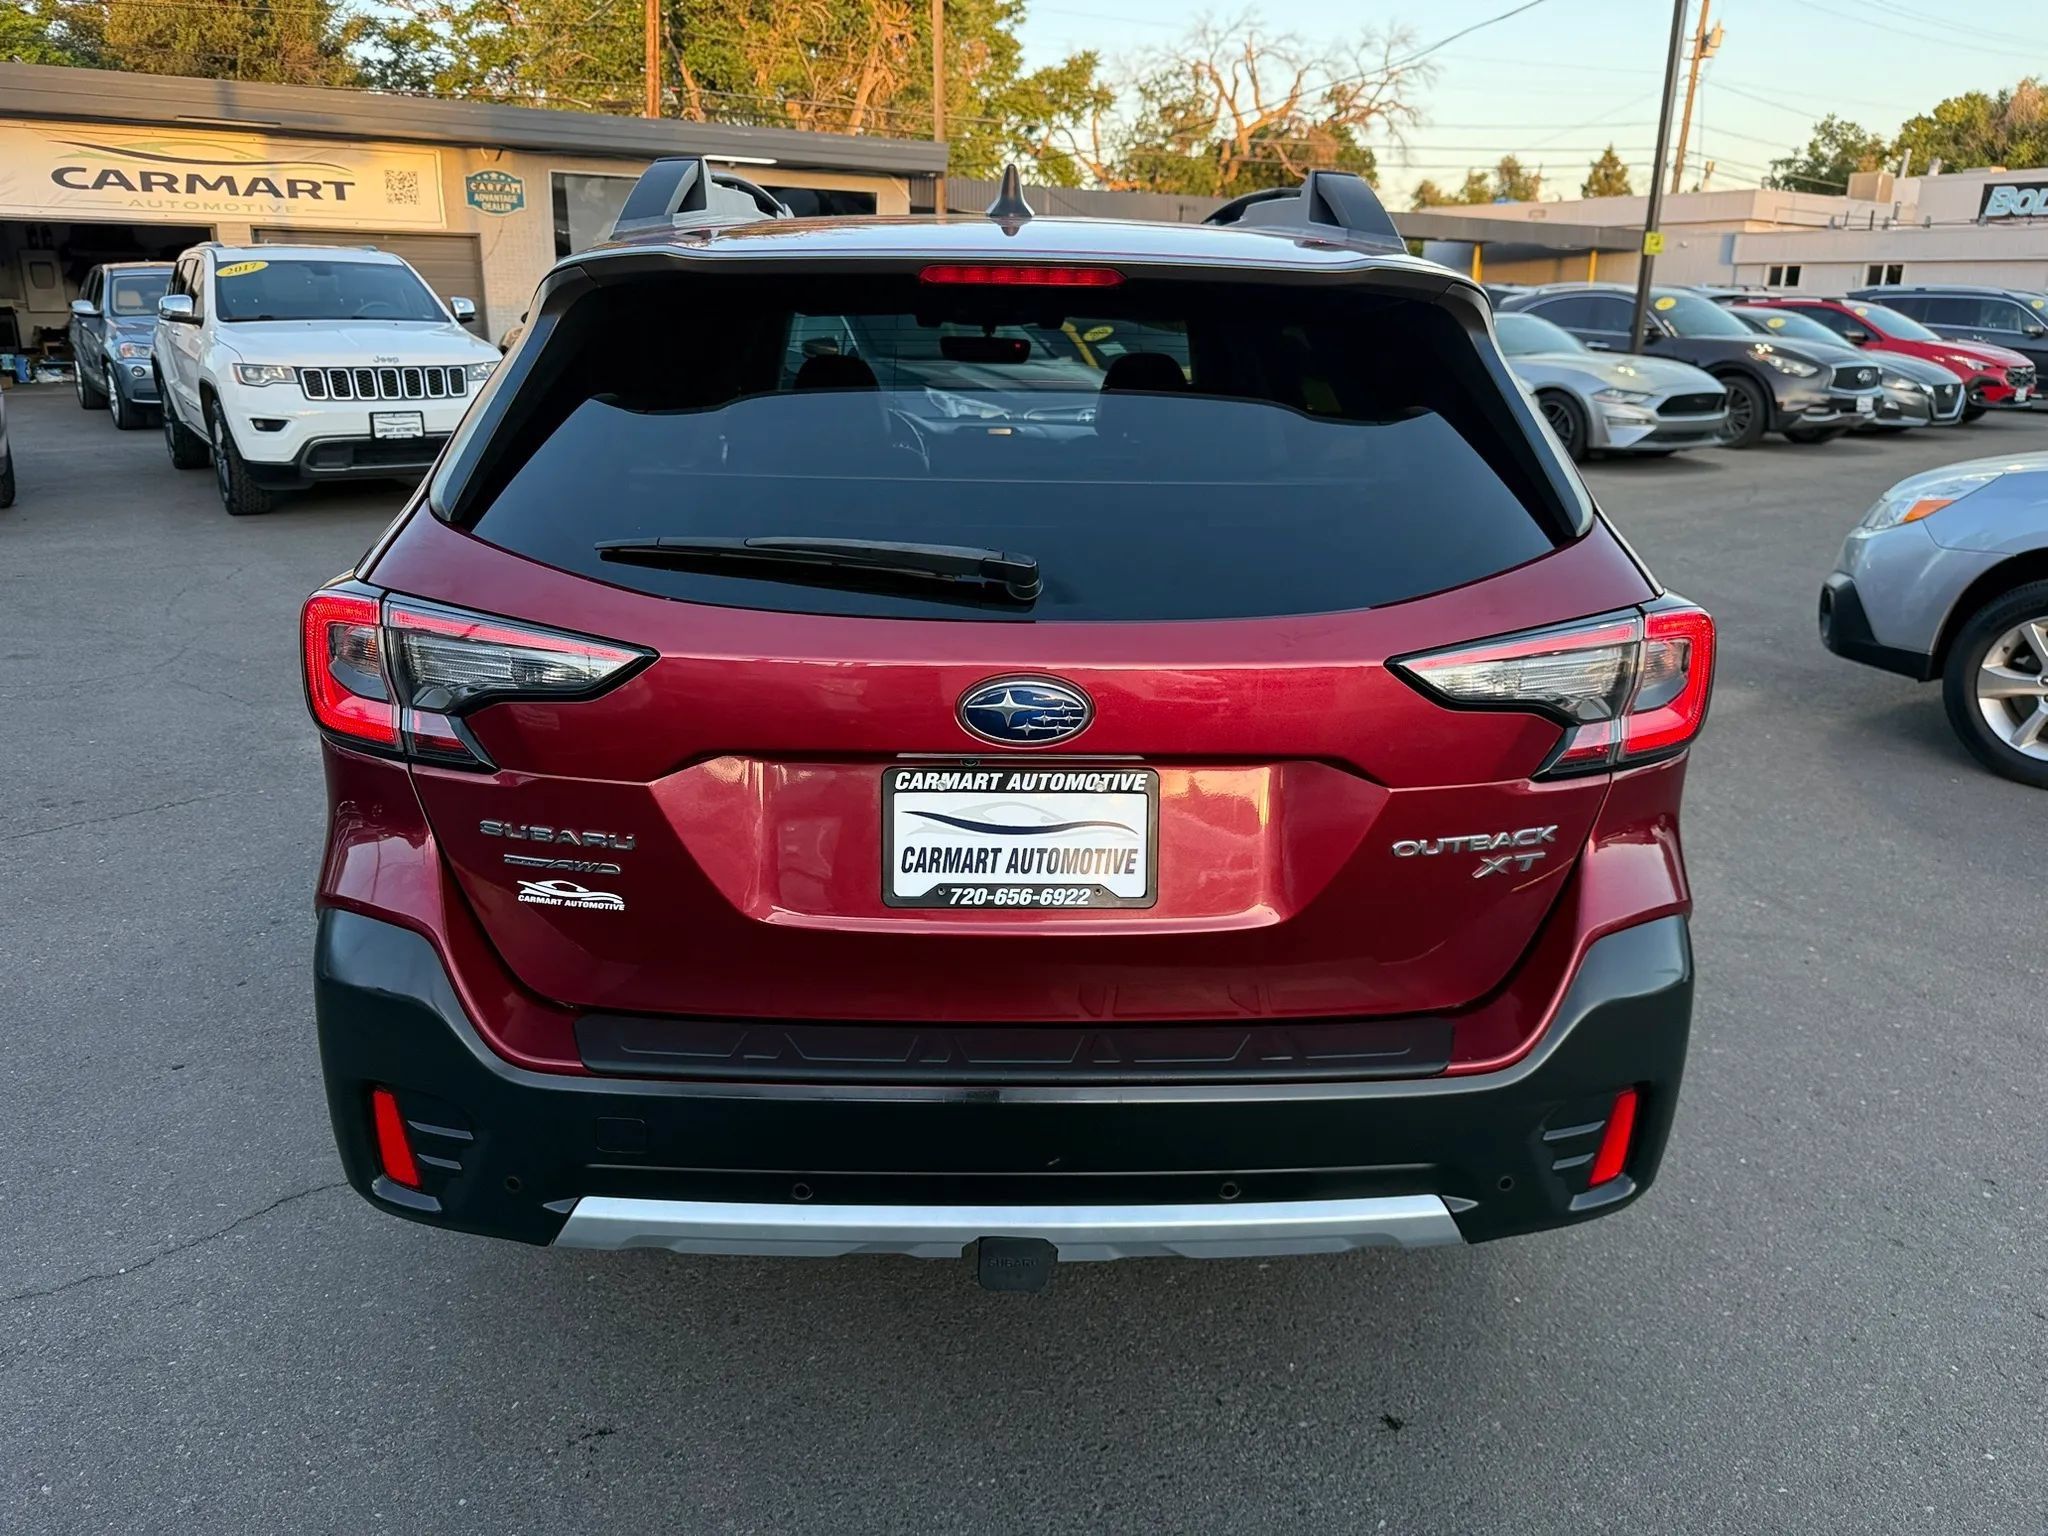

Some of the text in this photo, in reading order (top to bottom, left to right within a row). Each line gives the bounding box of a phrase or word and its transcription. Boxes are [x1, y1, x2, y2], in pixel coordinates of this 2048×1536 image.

[51, 167, 355, 201] CARMART
[128, 199, 298, 214] AUTOMOTIVE
[227, 262, 257, 275] 2017
[373, 355, 399, 363] Jeep
[894, 772, 1148, 792] CARMART AUTOMOTIVE
[479, 818, 637, 851] SUBARU
[1391, 825, 1559, 858] OUTBACK
[547, 859, 620, 874] AWD
[901, 846, 1139, 875] CARMART AUTOMOTIVE
[1472, 851, 1546, 879] XT
[517, 894, 626, 911] CARMART AUTOMOTIVE
[950, 887, 1091, 906] 720-656-6922
